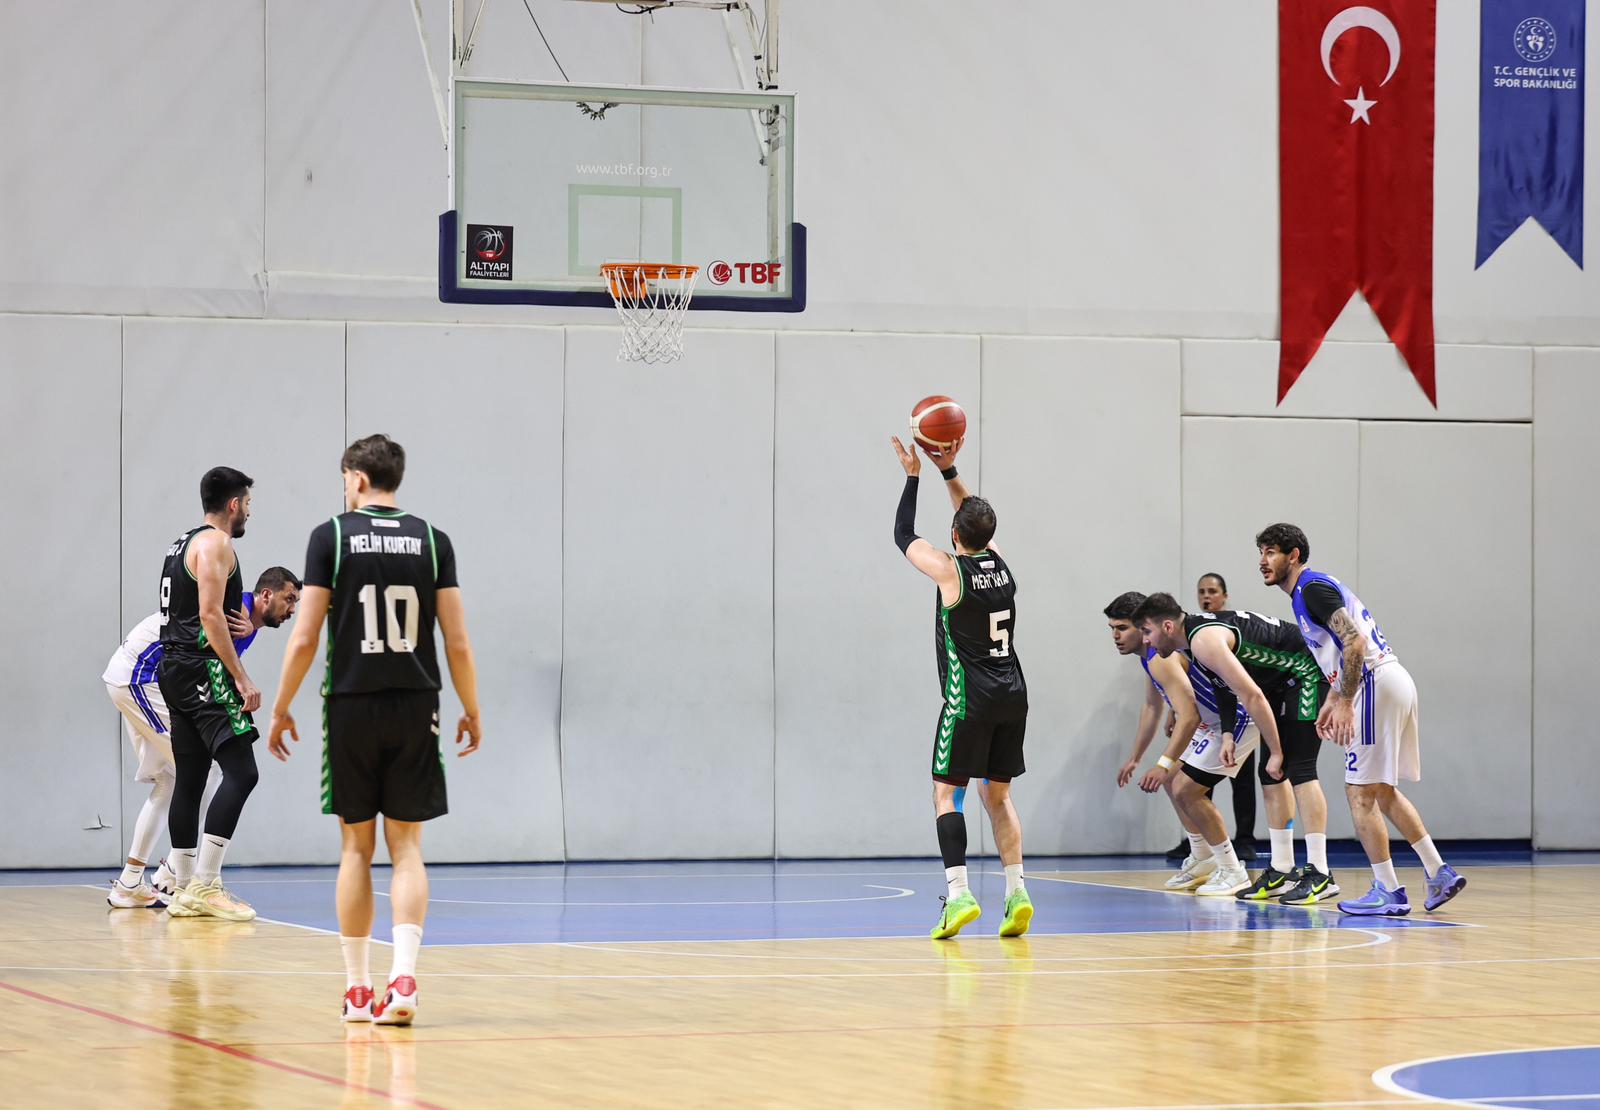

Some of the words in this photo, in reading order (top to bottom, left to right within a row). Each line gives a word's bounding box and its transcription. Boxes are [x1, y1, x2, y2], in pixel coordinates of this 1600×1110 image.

[1494, 66, 1512, 76] T.C.
[1515, 67, 1560, 78] GENÇLİK
[1562, 68, 1576, 77] VE
[1494, 78, 1520, 88] SPOR
[1522, 79, 1577, 89] BAKANLIĞI
[576, 160, 672, 178] www.tbf.org.tr
[470, 261, 509, 272] ALTYAPI
[734, 262, 782, 284] TBF
[350, 531, 382, 554] MELİH
[383, 536, 421, 555] KURTAY
[358, 584, 420, 654] 10
[989, 609, 1011, 657] 5
[1195, 739, 1209, 755] 8
